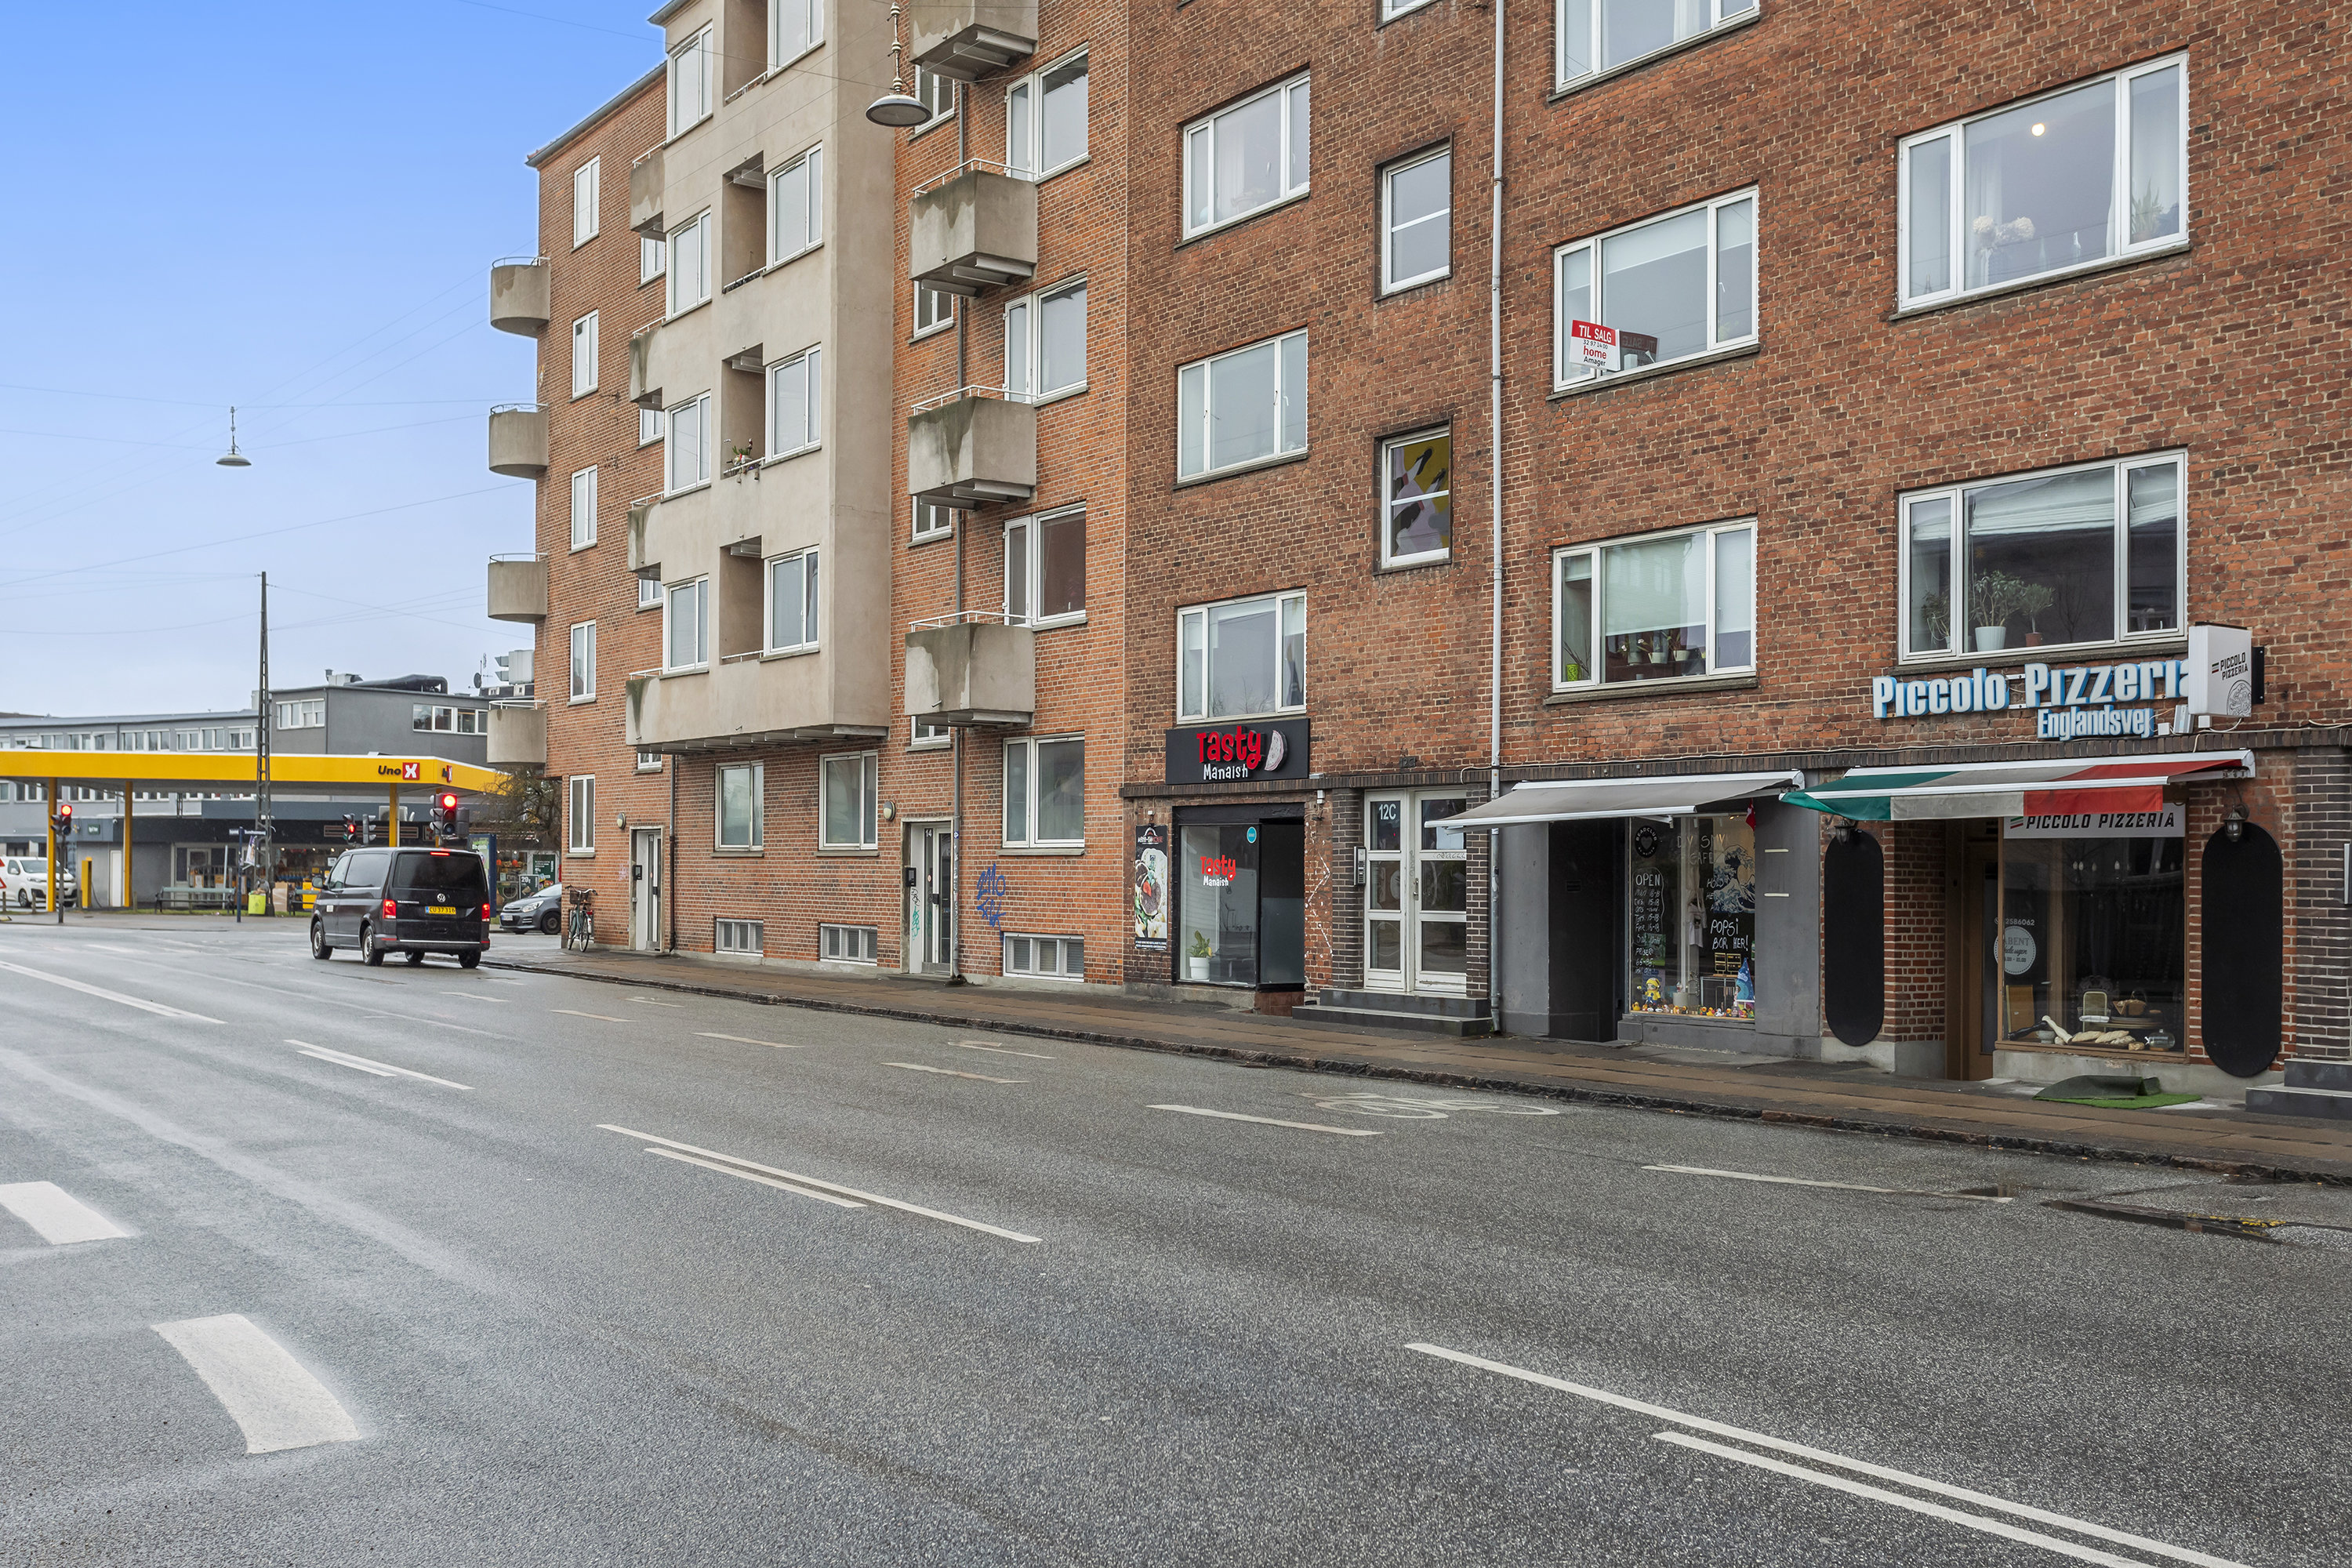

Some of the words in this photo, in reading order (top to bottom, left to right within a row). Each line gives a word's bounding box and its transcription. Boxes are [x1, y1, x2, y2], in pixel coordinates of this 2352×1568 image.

[1579, 325, 1592, 339] TIL
[1594, 328, 1612, 343] SALG
[1583, 345, 1607, 360] home
[1583, 356, 1606, 367] Amager
[2220, 652, 2246, 671] PICCOLO
[2222, 663, 2249, 681] PIZZERIA
[1872, 668, 2009, 718] Piccolo
[2038, 704, 2154, 741] Englandsvej
[1196, 725, 1262, 770] Tasty
[1400, 757, 1414, 767] 12C
[378, 765, 401, 775] Uno
[405, 763, 418, 779] X
[1203, 763, 1248, 780] Manaish
[1378, 803, 1396, 820] 12C
[2026, 814, 2092, 829] PICCOLO
[2098, 812, 2175, 829] PIZZERIA
[924, 829, 932, 837] 14
[1200, 855, 1236, 881] Tasty
[1203, 875, 1229, 887] Manaish
[1635, 873, 1661, 887] OPEN
